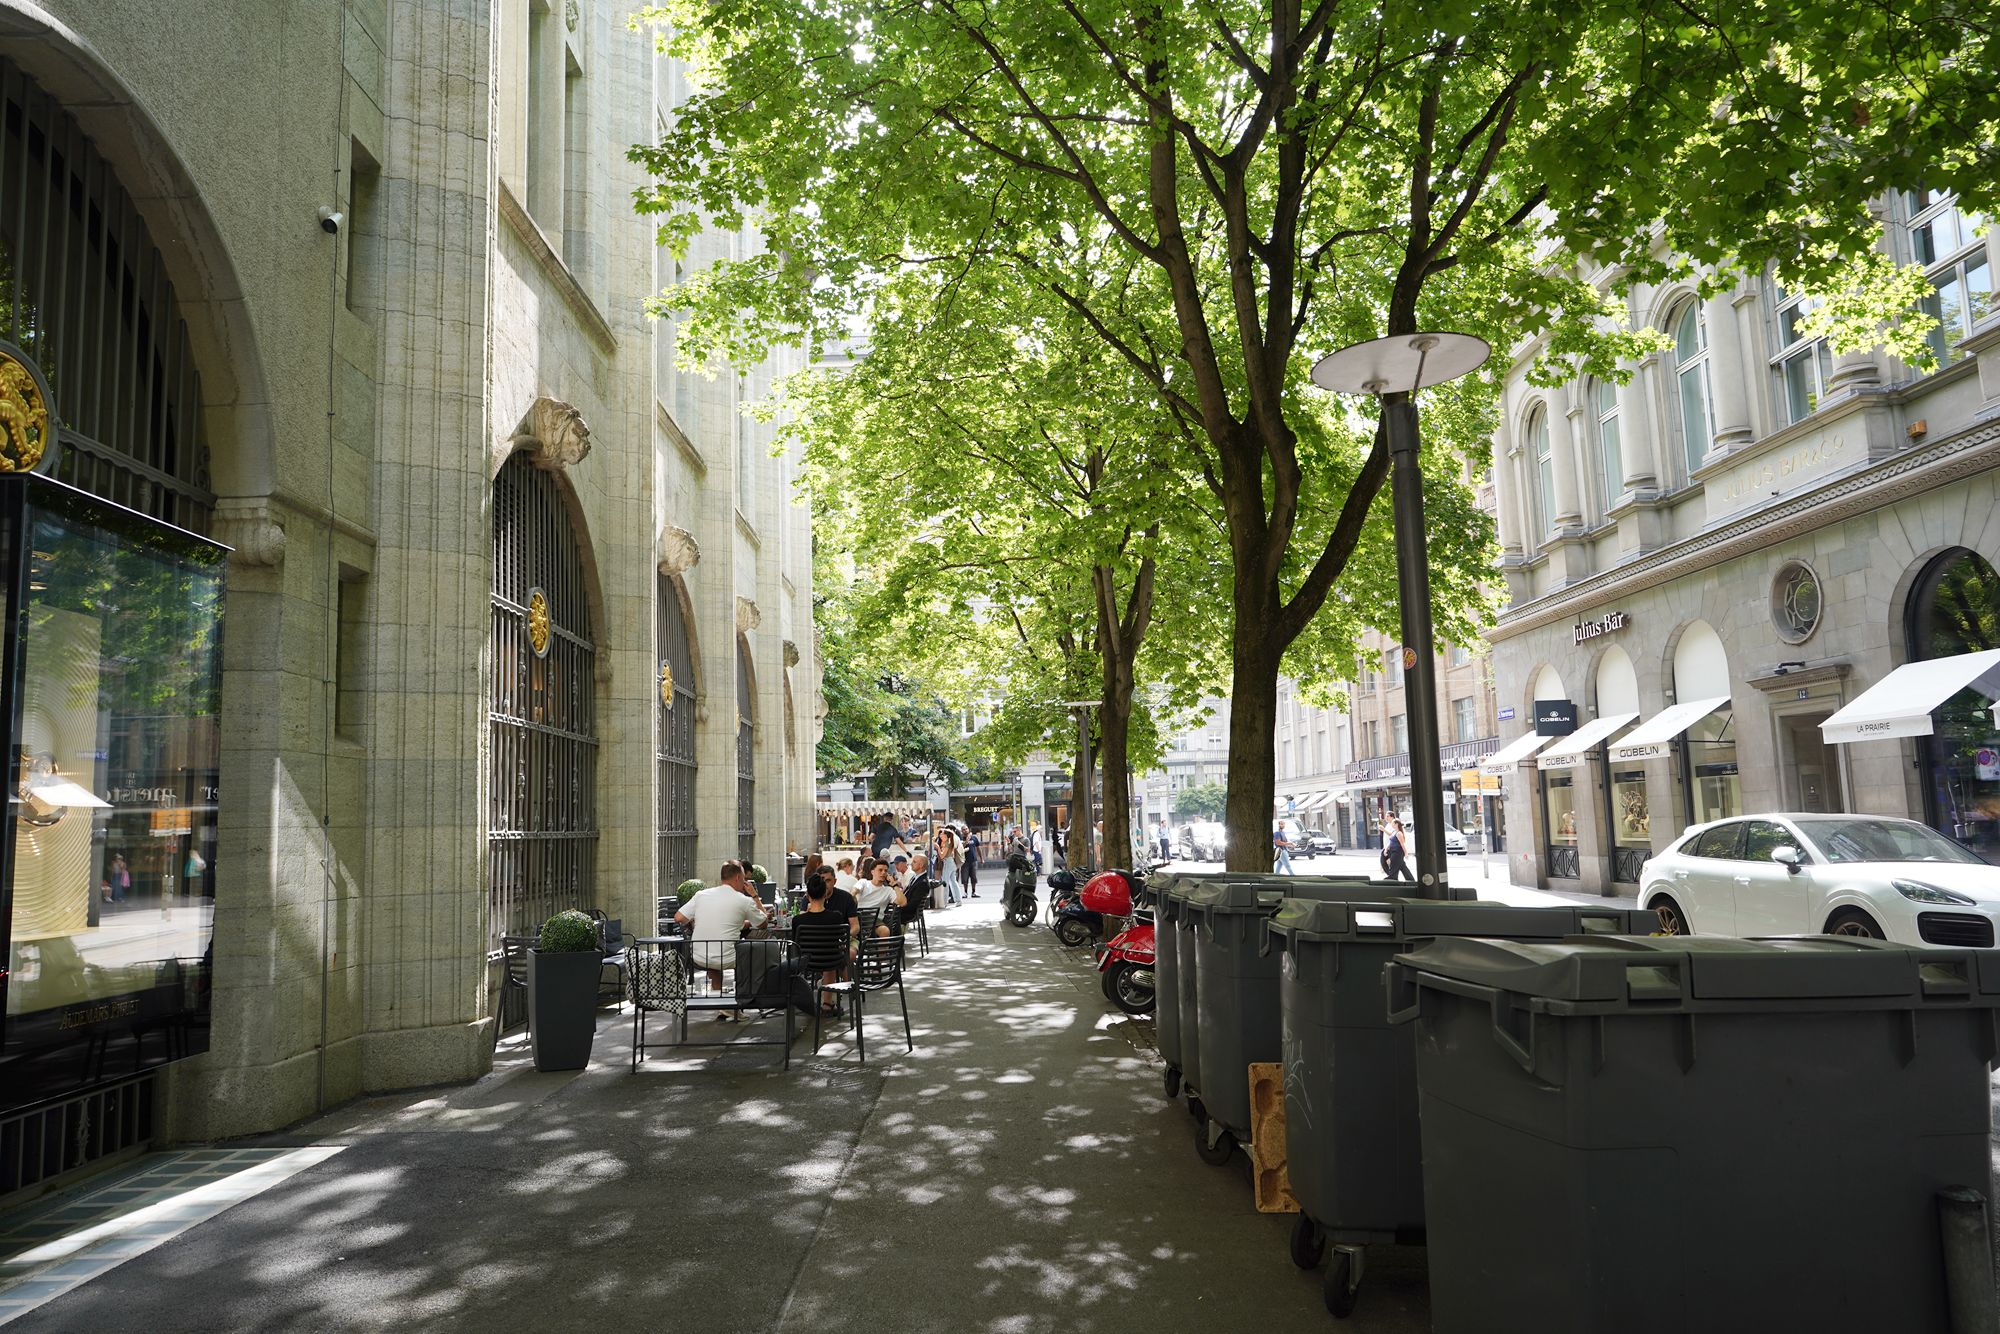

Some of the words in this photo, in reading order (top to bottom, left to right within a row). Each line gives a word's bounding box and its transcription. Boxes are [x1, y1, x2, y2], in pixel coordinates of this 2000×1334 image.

[1572, 622, 1601, 647] Julius
[1604, 611, 1624, 633] Bär
[1856, 725, 1864, 733] LA
[1865, 722, 1890, 731] PRAIRIE
